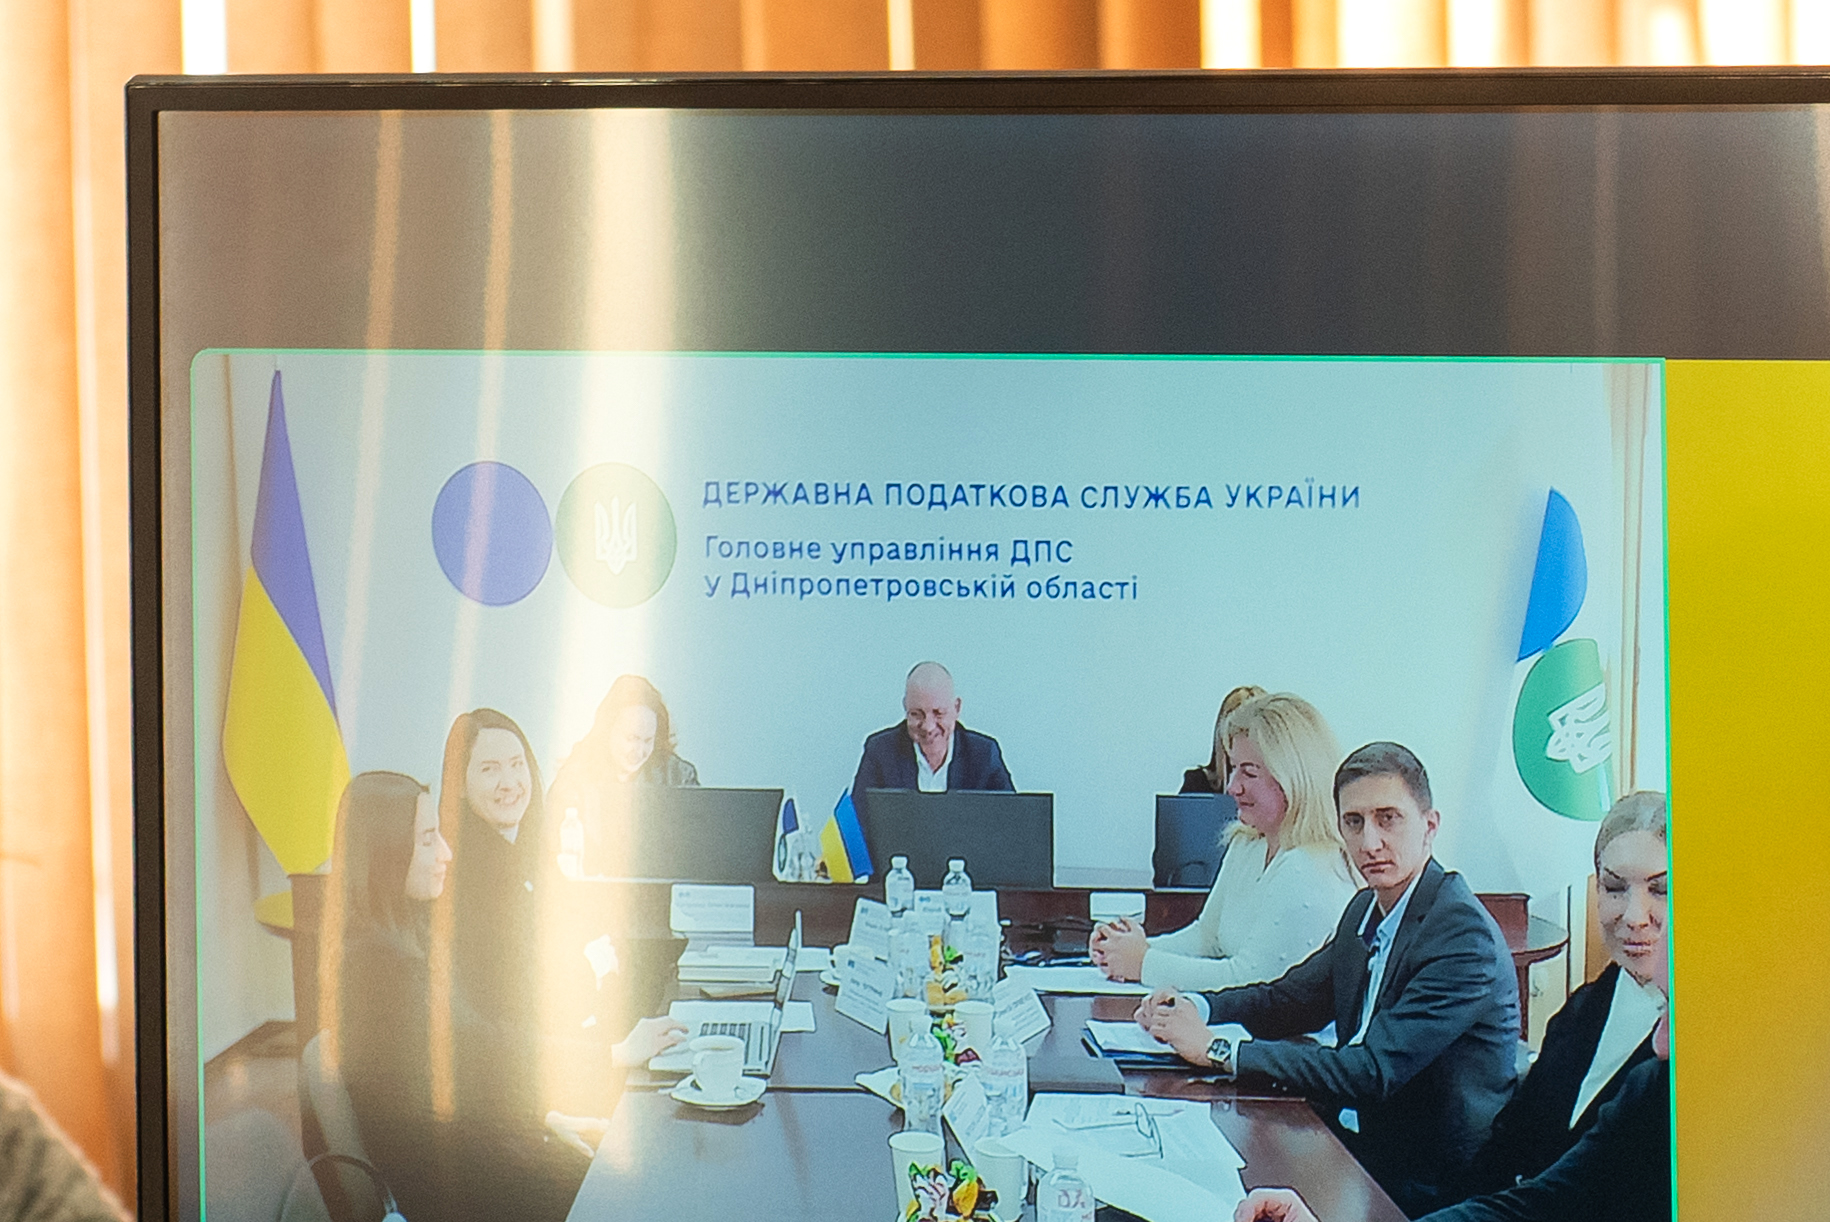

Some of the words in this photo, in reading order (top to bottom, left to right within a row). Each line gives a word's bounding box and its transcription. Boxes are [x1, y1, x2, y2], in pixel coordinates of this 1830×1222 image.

[704, 482, 873, 506] ДЕРЖАВНА
[886, 483, 1069, 510] ПОДАТКОВА
[1081, 486, 1212, 509] СЛУЖБА
[1226, 477, 1360, 508] УКРАЇНИ
[705, 535, 822, 560] Головне
[831, 537, 998, 565] управління
[1011, 540, 1072, 566] ДПС
[705, 576, 721, 597] у
[731, 572, 1015, 601] Дніпропетровській
[1027, 575, 1137, 599] області
